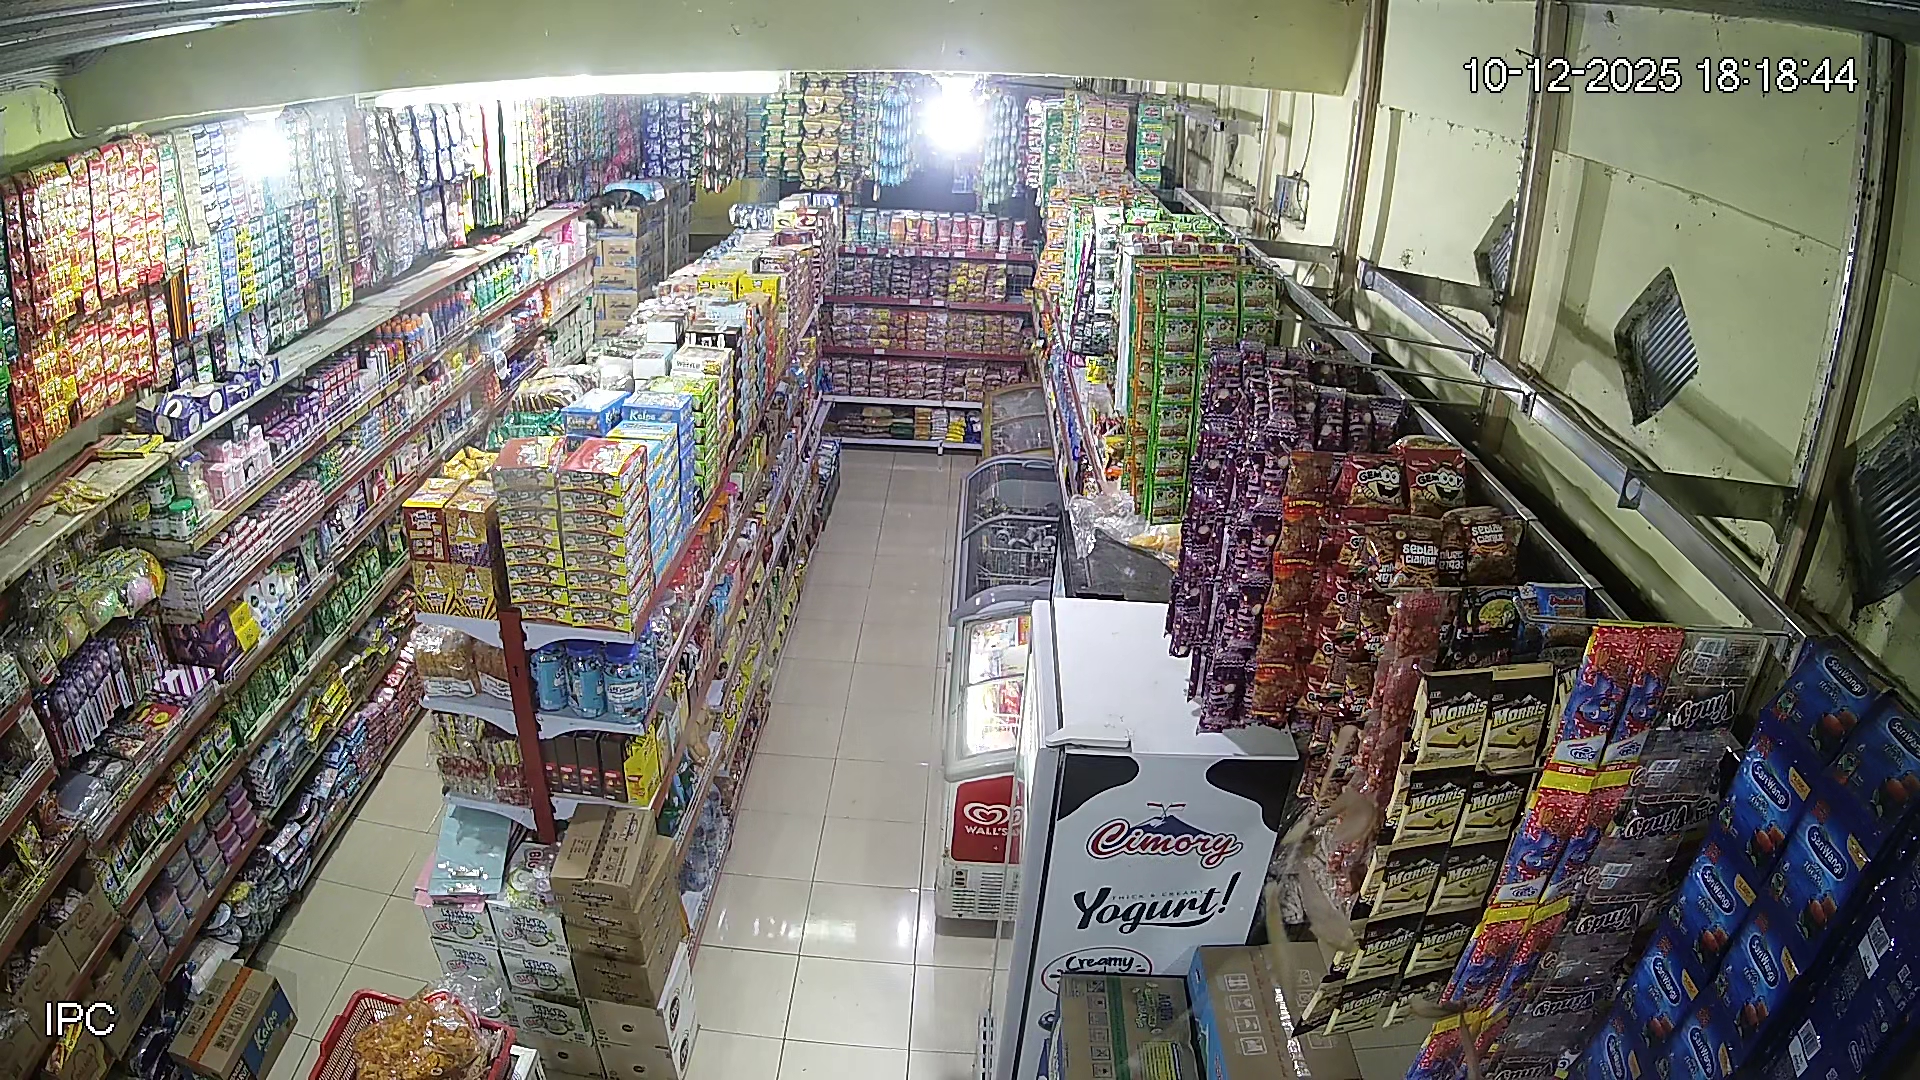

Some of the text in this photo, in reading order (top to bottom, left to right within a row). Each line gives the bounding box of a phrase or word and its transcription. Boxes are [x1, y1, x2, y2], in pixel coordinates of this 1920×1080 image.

[1753, 762, 1787, 806] SariWangi
[964, 825, 1008, 836] WALL'S
[1088, 820, 1242, 868] Cimory
[1810, 830, 1844, 876] SariWangi
[1074, 872, 1241, 934] Yogurt!
[1703, 869, 1731, 910] SariWangi
[1065, 955, 1135, 972] Creamy
